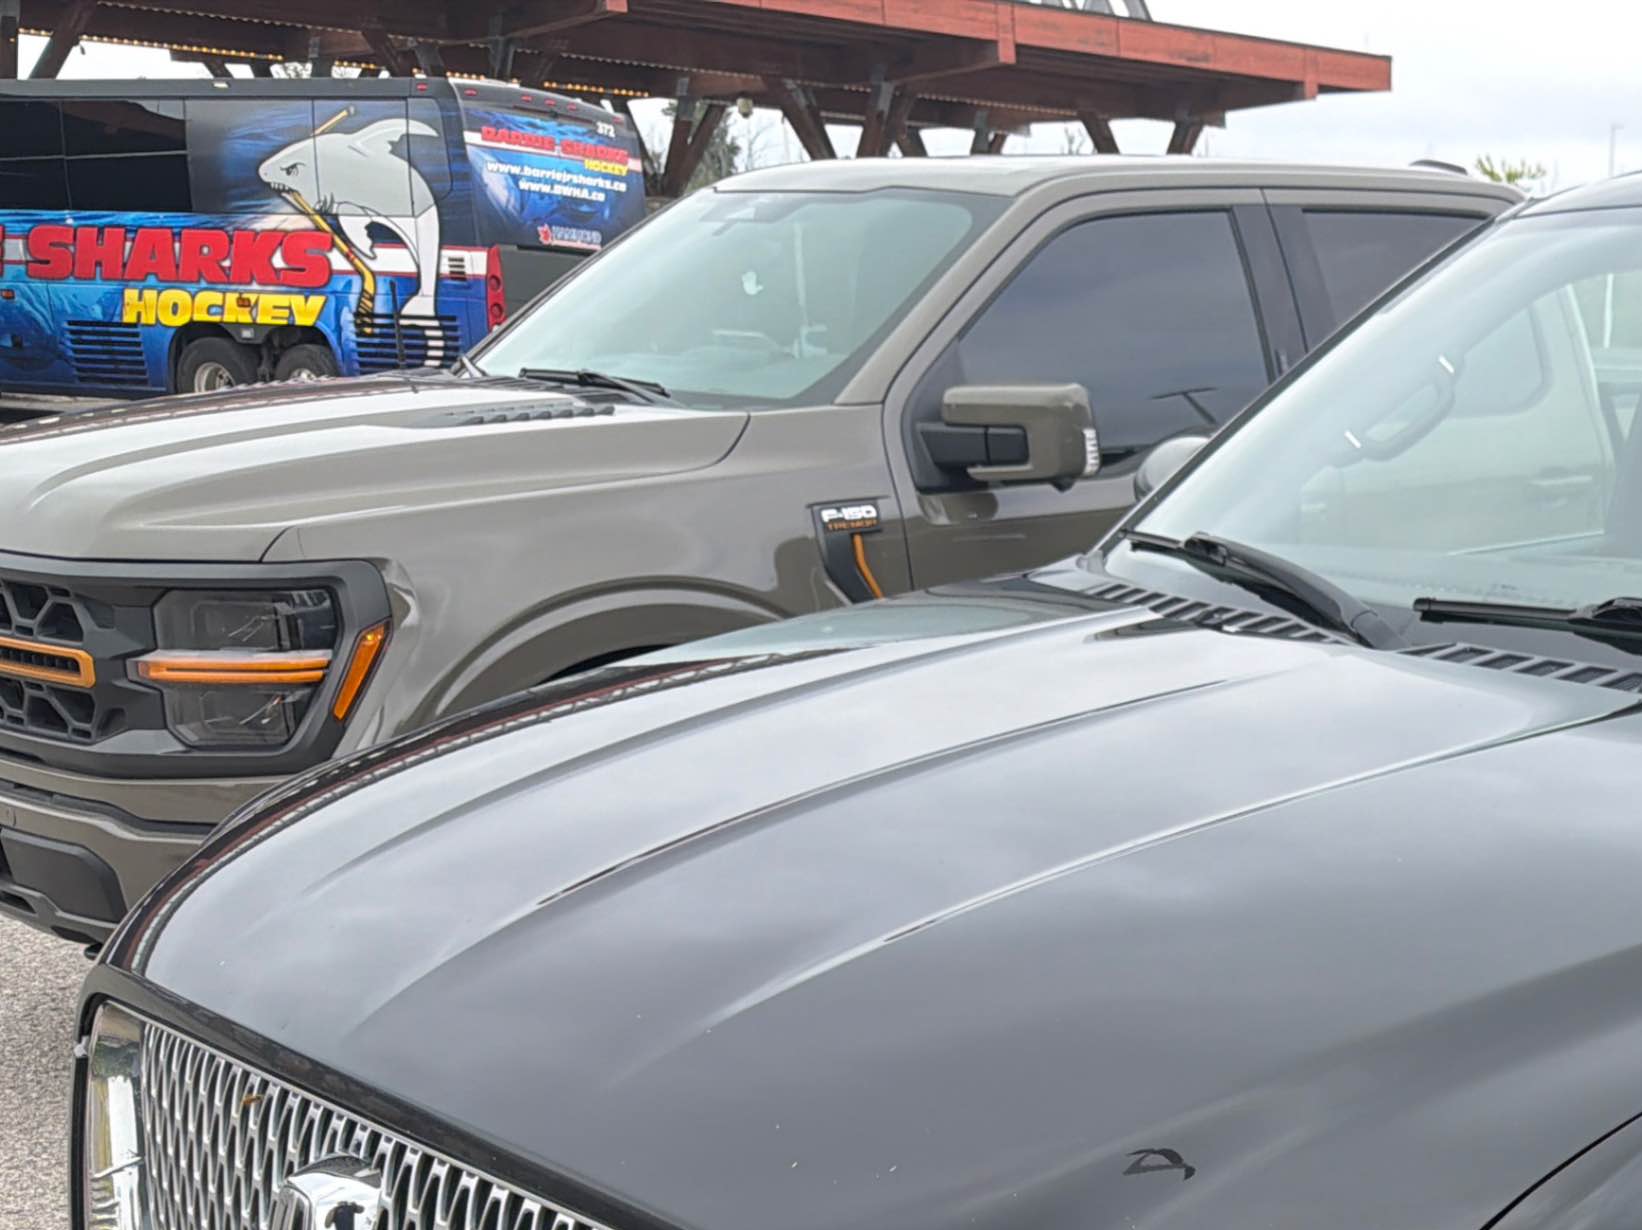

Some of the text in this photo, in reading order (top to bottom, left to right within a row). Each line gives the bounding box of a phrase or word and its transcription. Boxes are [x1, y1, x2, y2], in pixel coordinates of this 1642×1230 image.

[560, 140, 629, 166] SHARKS
[585, 159, 628, 176] HOCKEY
[26, 224, 334, 288] SHARKS
[120, 287, 327, 327] HOCKEY
